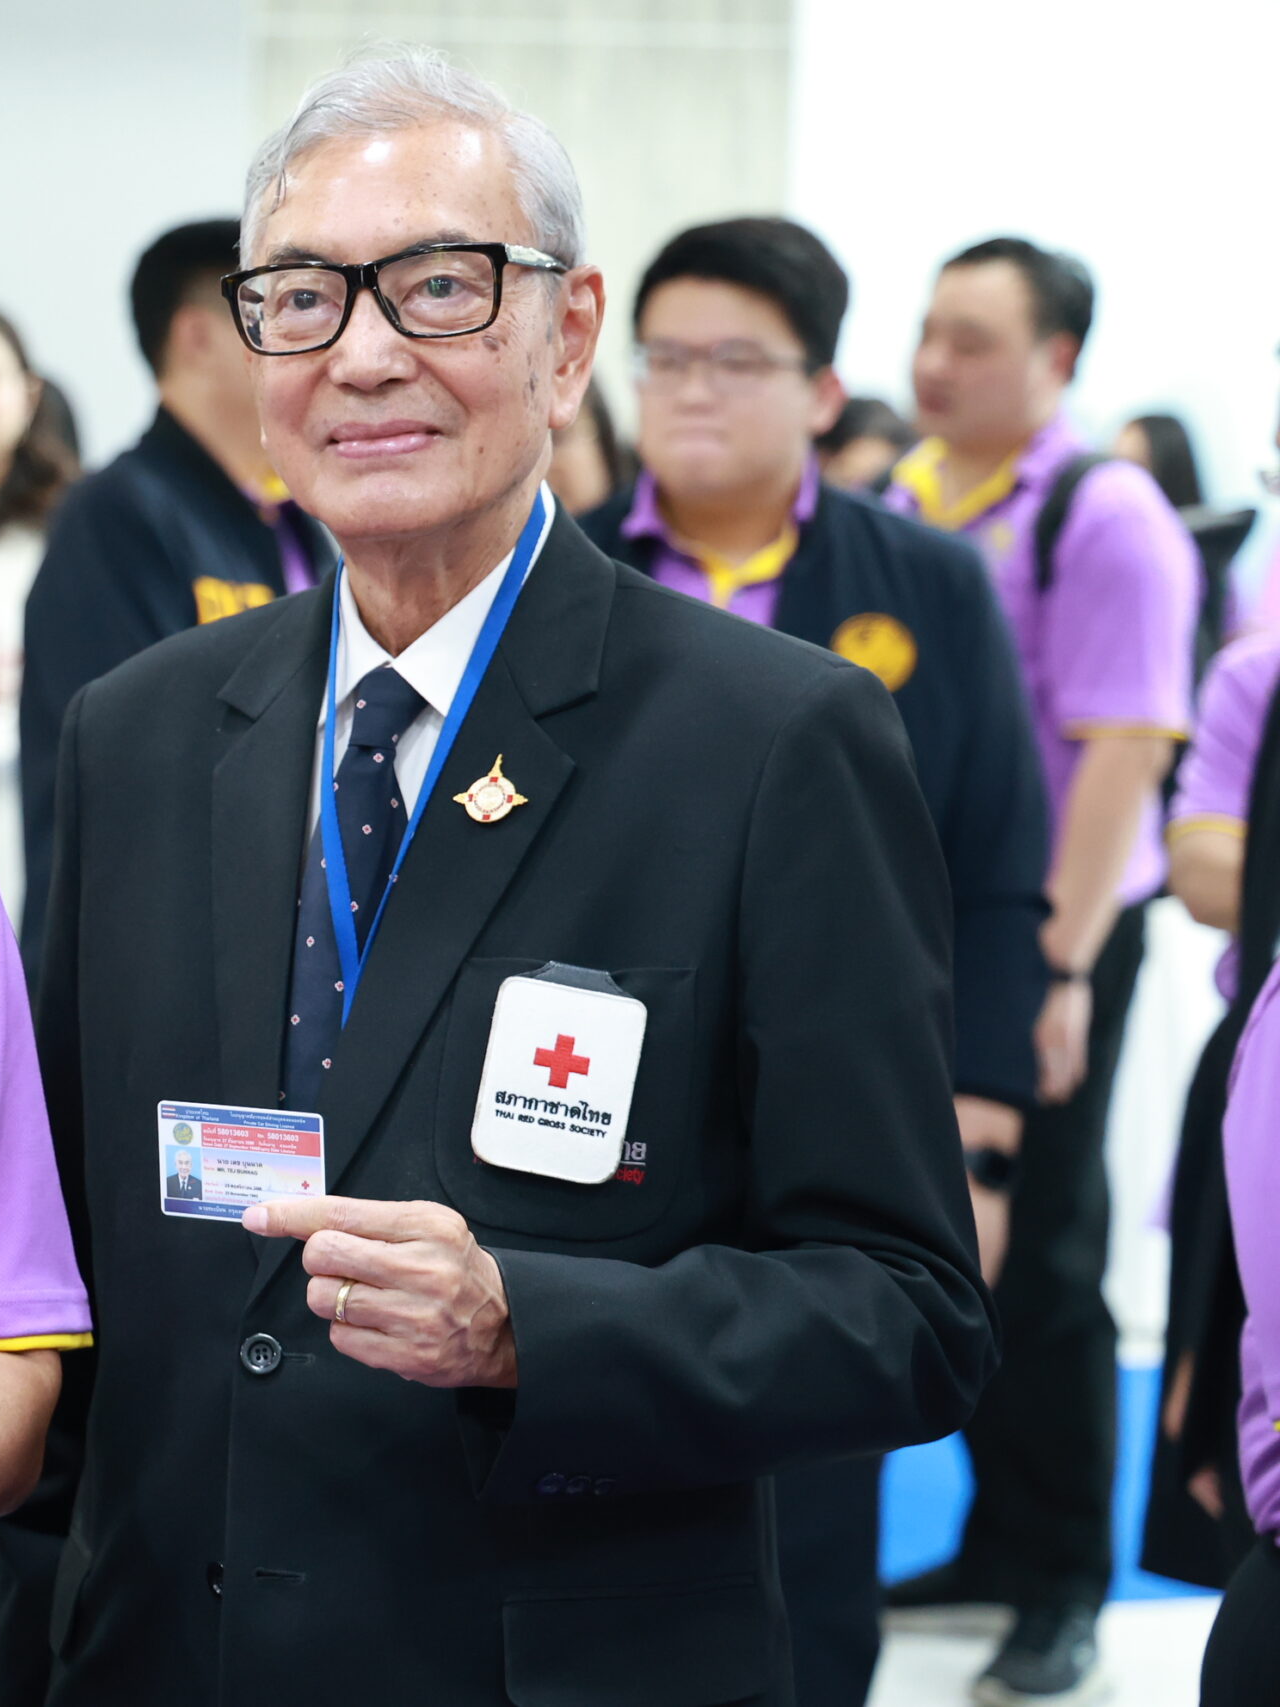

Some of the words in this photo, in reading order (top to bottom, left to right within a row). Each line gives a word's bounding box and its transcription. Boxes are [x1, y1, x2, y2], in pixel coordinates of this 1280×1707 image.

[495, 1090, 612, 1125] สภากาชาดไทย
[495, 1110, 514, 1119] THAI
[518, 1114, 535, 1124] RED
[538, 1118, 565, 1130] CROSS
[570, 1124, 607, 1138] SOCIETY
